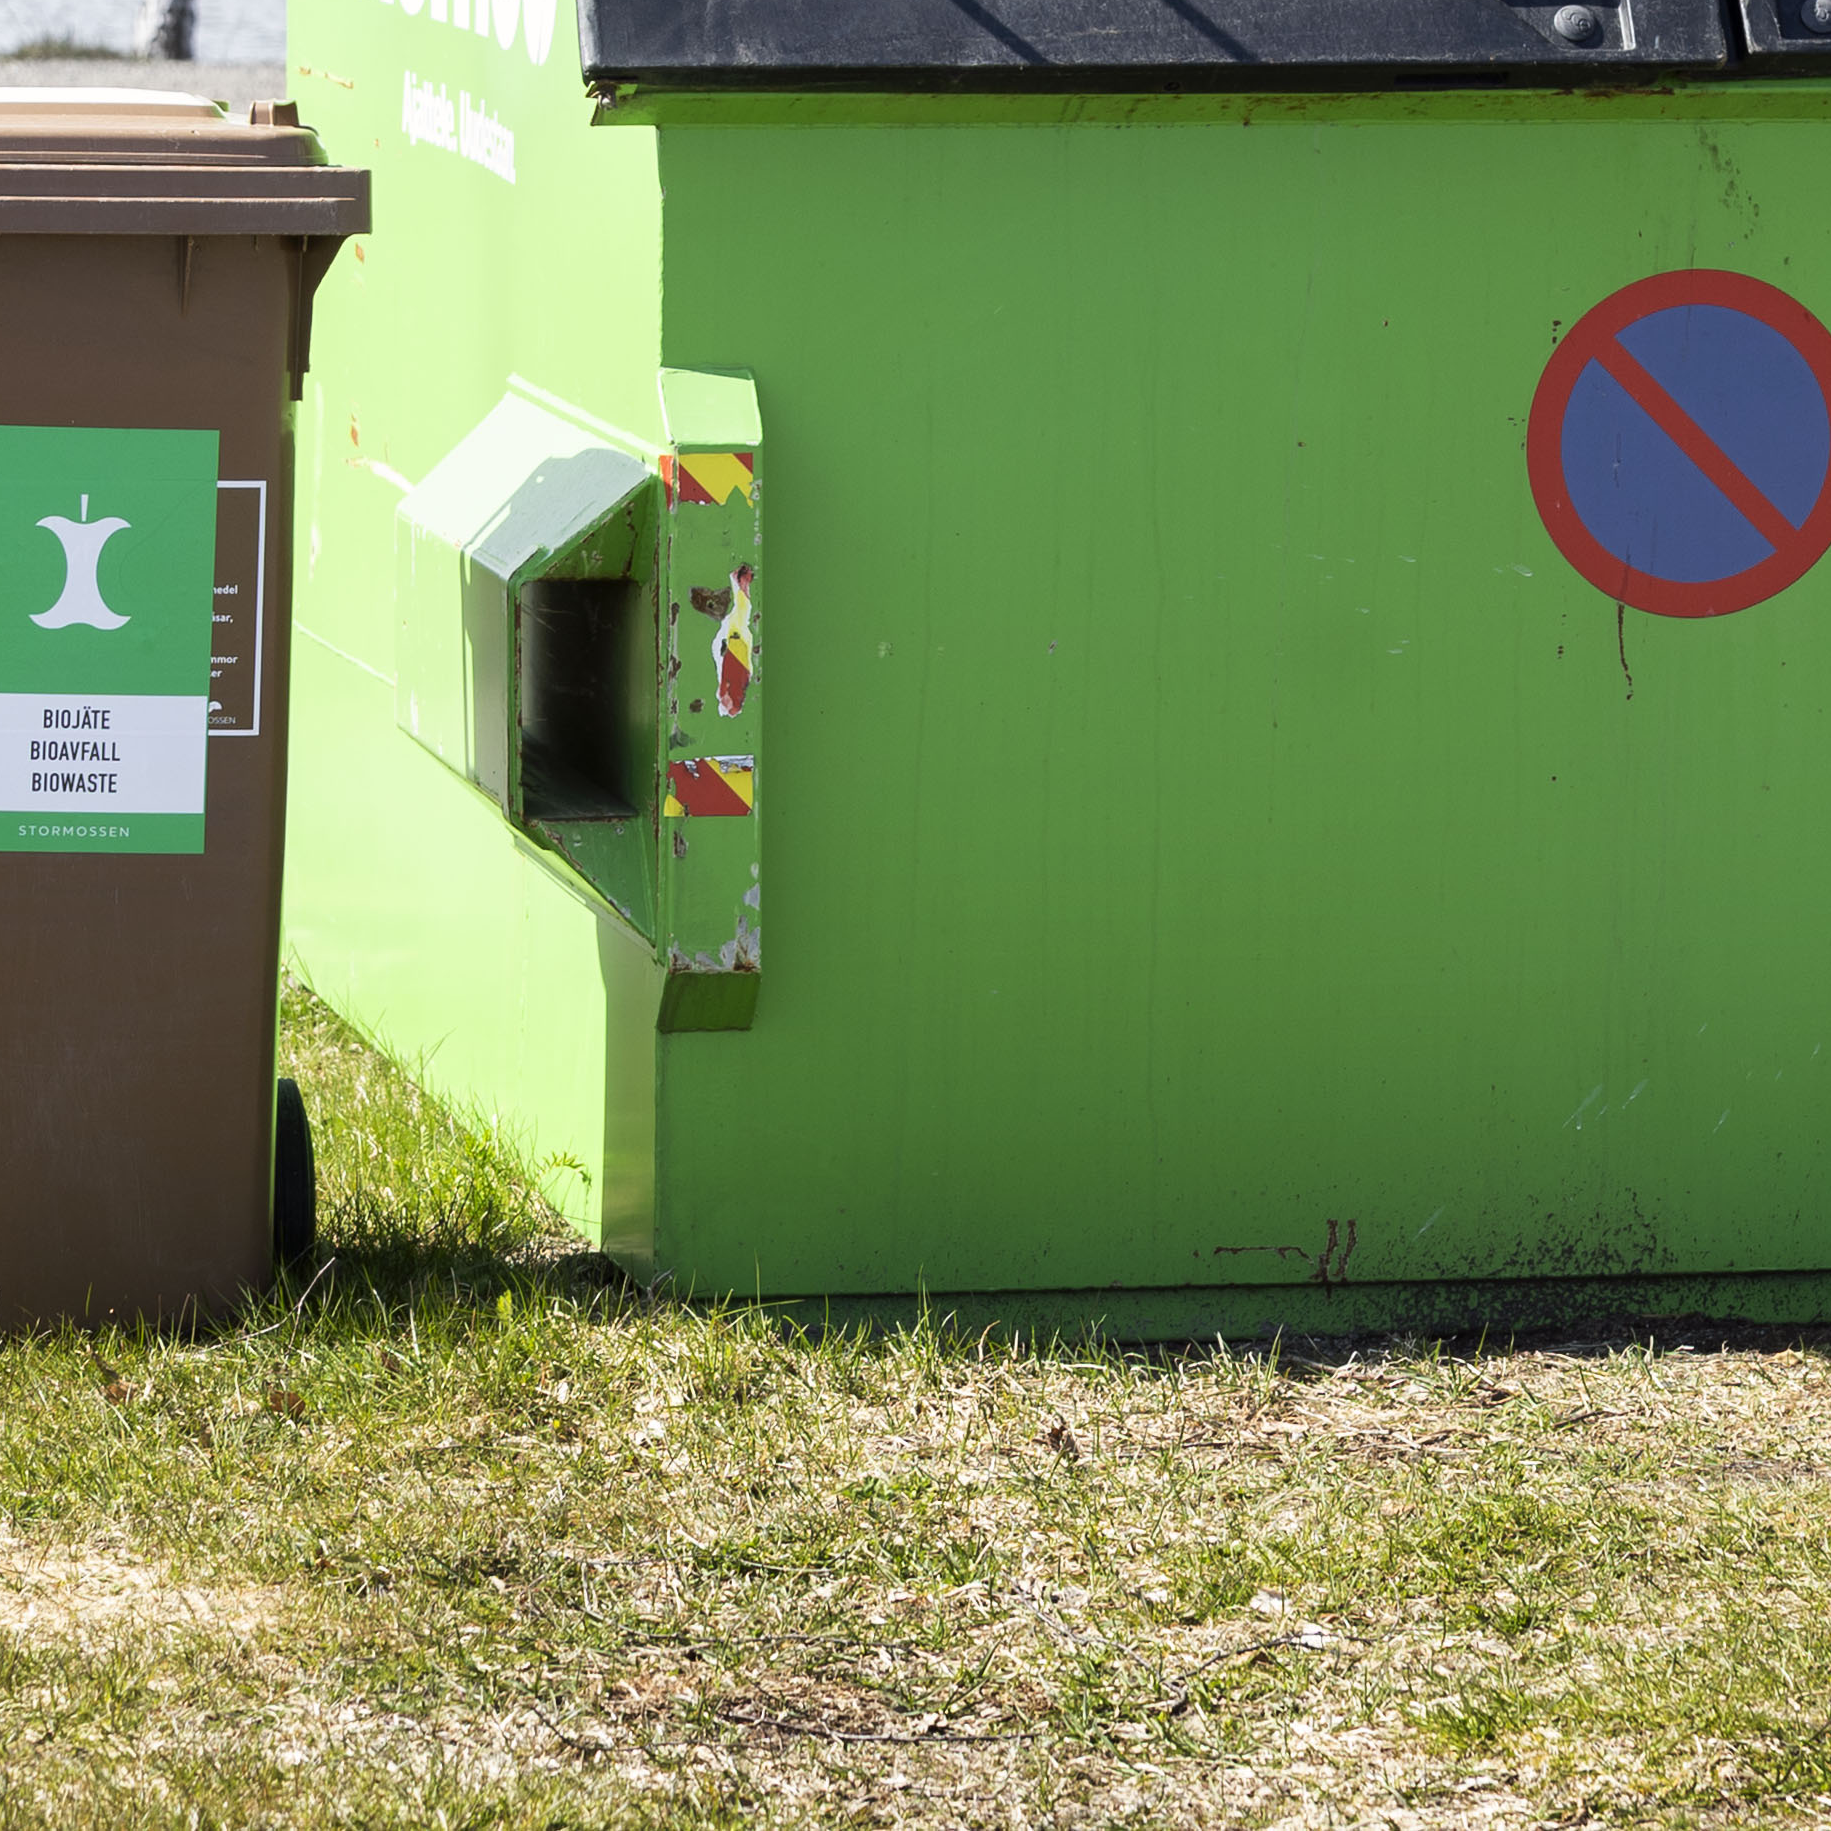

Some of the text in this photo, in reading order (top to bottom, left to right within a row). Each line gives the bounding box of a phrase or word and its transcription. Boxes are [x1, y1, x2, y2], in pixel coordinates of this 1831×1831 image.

[43, 706, 112, 730] BIOJÄTE
[30, 741, 121, 762] BIOAVFALL
[31, 772, 118, 794] BIOWASTE
[18, 825, 131, 838] STORMOSSEN
